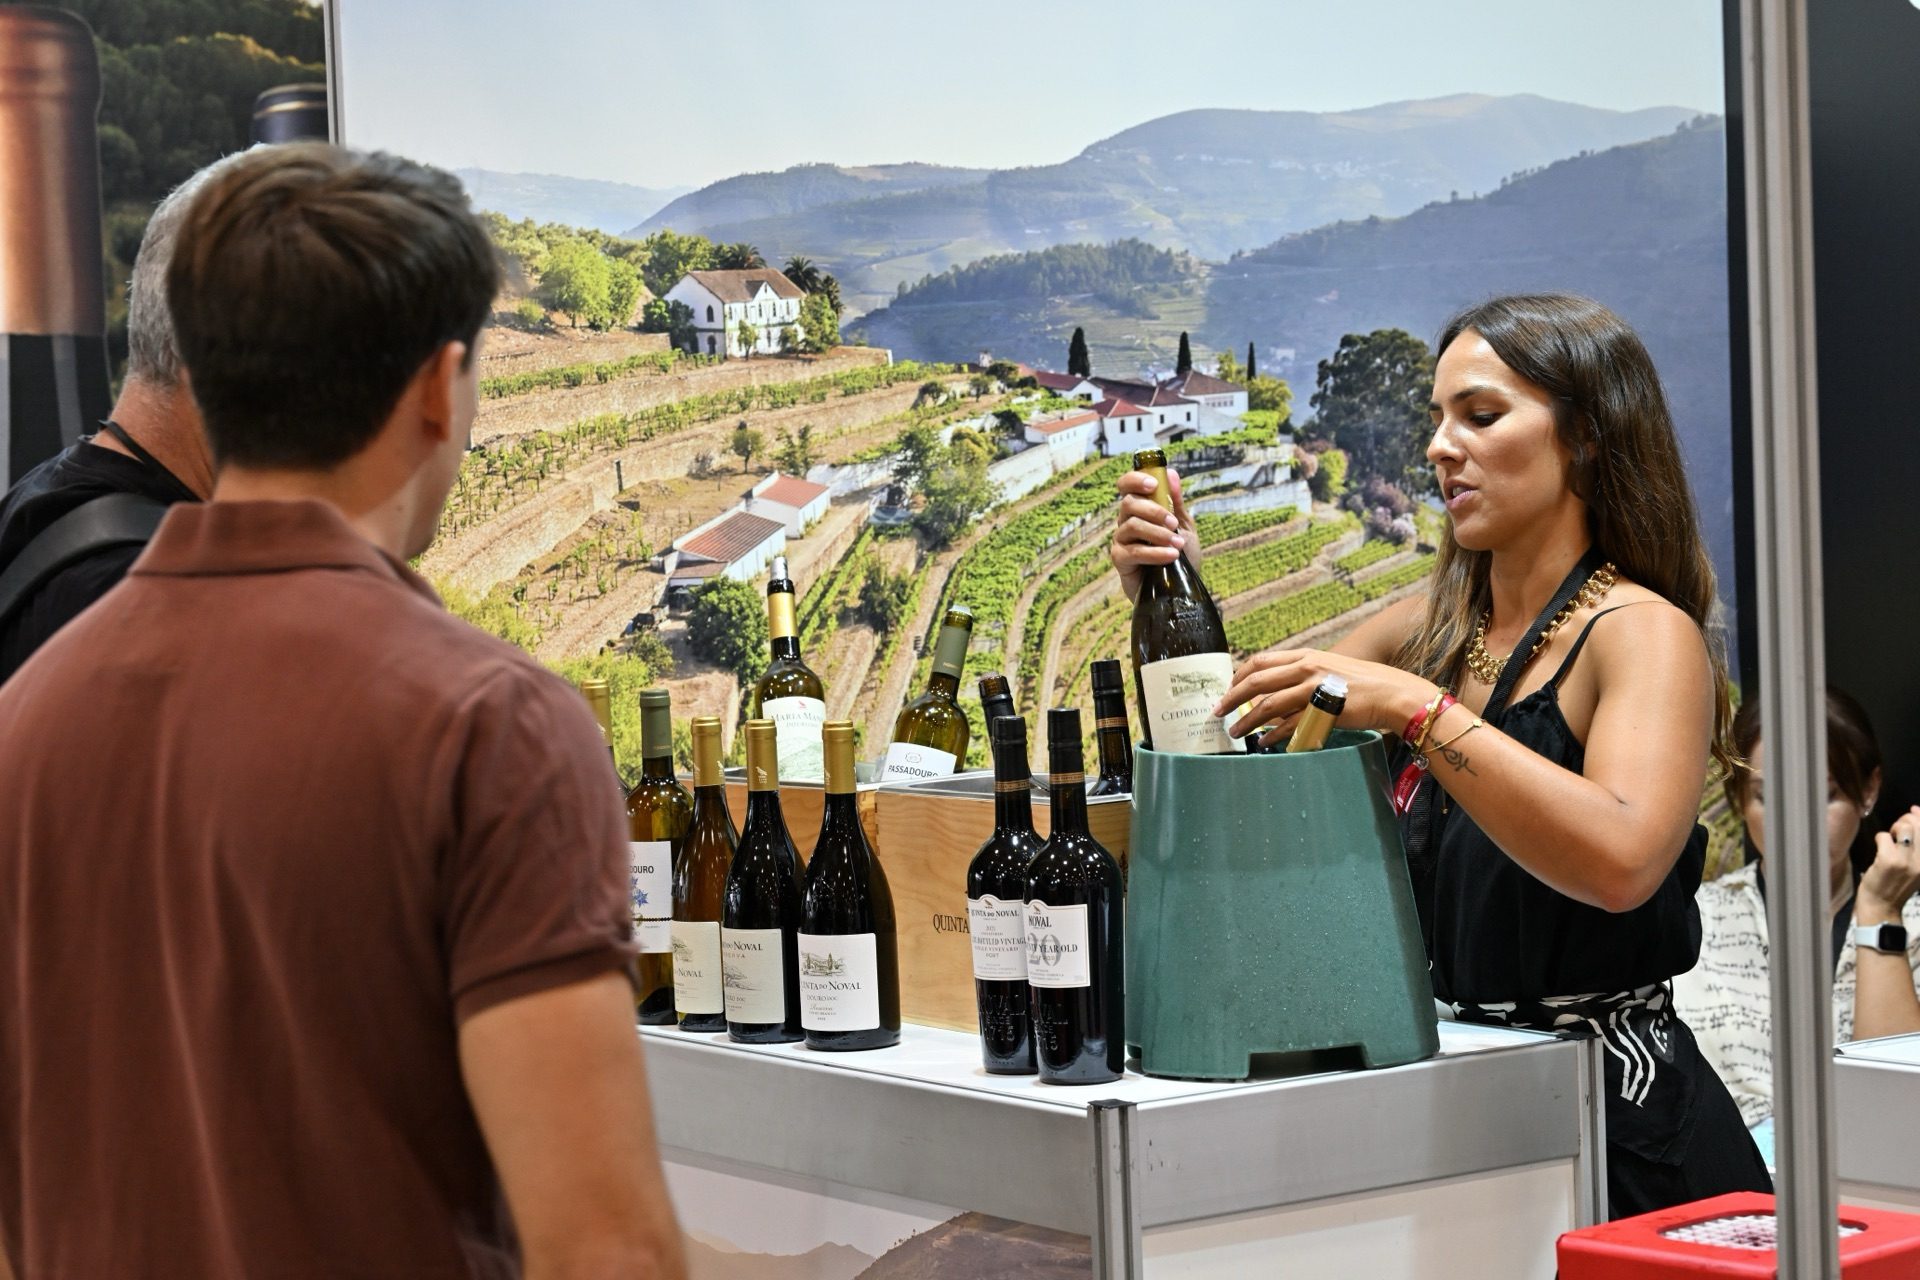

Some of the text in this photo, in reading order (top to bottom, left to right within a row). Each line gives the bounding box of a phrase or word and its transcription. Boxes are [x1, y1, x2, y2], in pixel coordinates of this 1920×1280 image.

[996, 908, 1019, 918] NOVAL
[932, 913, 970, 934] QUINTA
[1028, 915, 1052, 928] NOVAL
[734, 941, 763, 951] NOVAL
[1060, 943, 1078, 953] OLD
[829, 981, 862, 991] NOVAL
